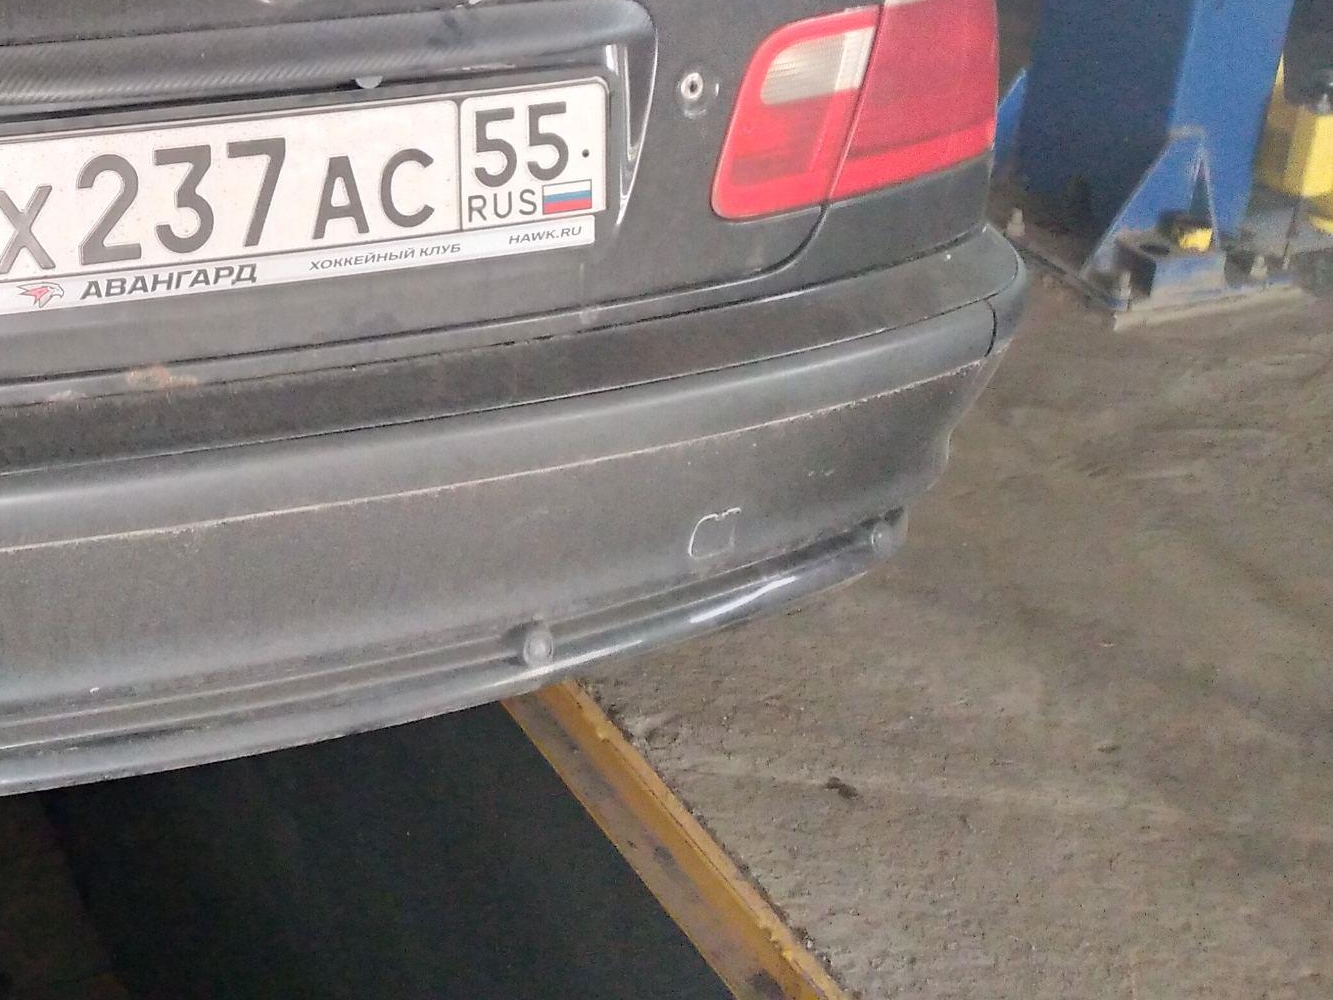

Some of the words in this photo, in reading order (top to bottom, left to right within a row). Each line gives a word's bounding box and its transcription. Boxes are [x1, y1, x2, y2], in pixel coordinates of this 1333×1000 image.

[474, 101, 569, 188] 55
[468, 189, 537, 223] RUS
[509, 226, 582, 245] HAWK.RU
[309, 247, 415, 270] ХОККЕЙНЫЙ
[419, 243, 461, 256] КЛУБ
[80, 263, 257, 300] АВАНГАРД
